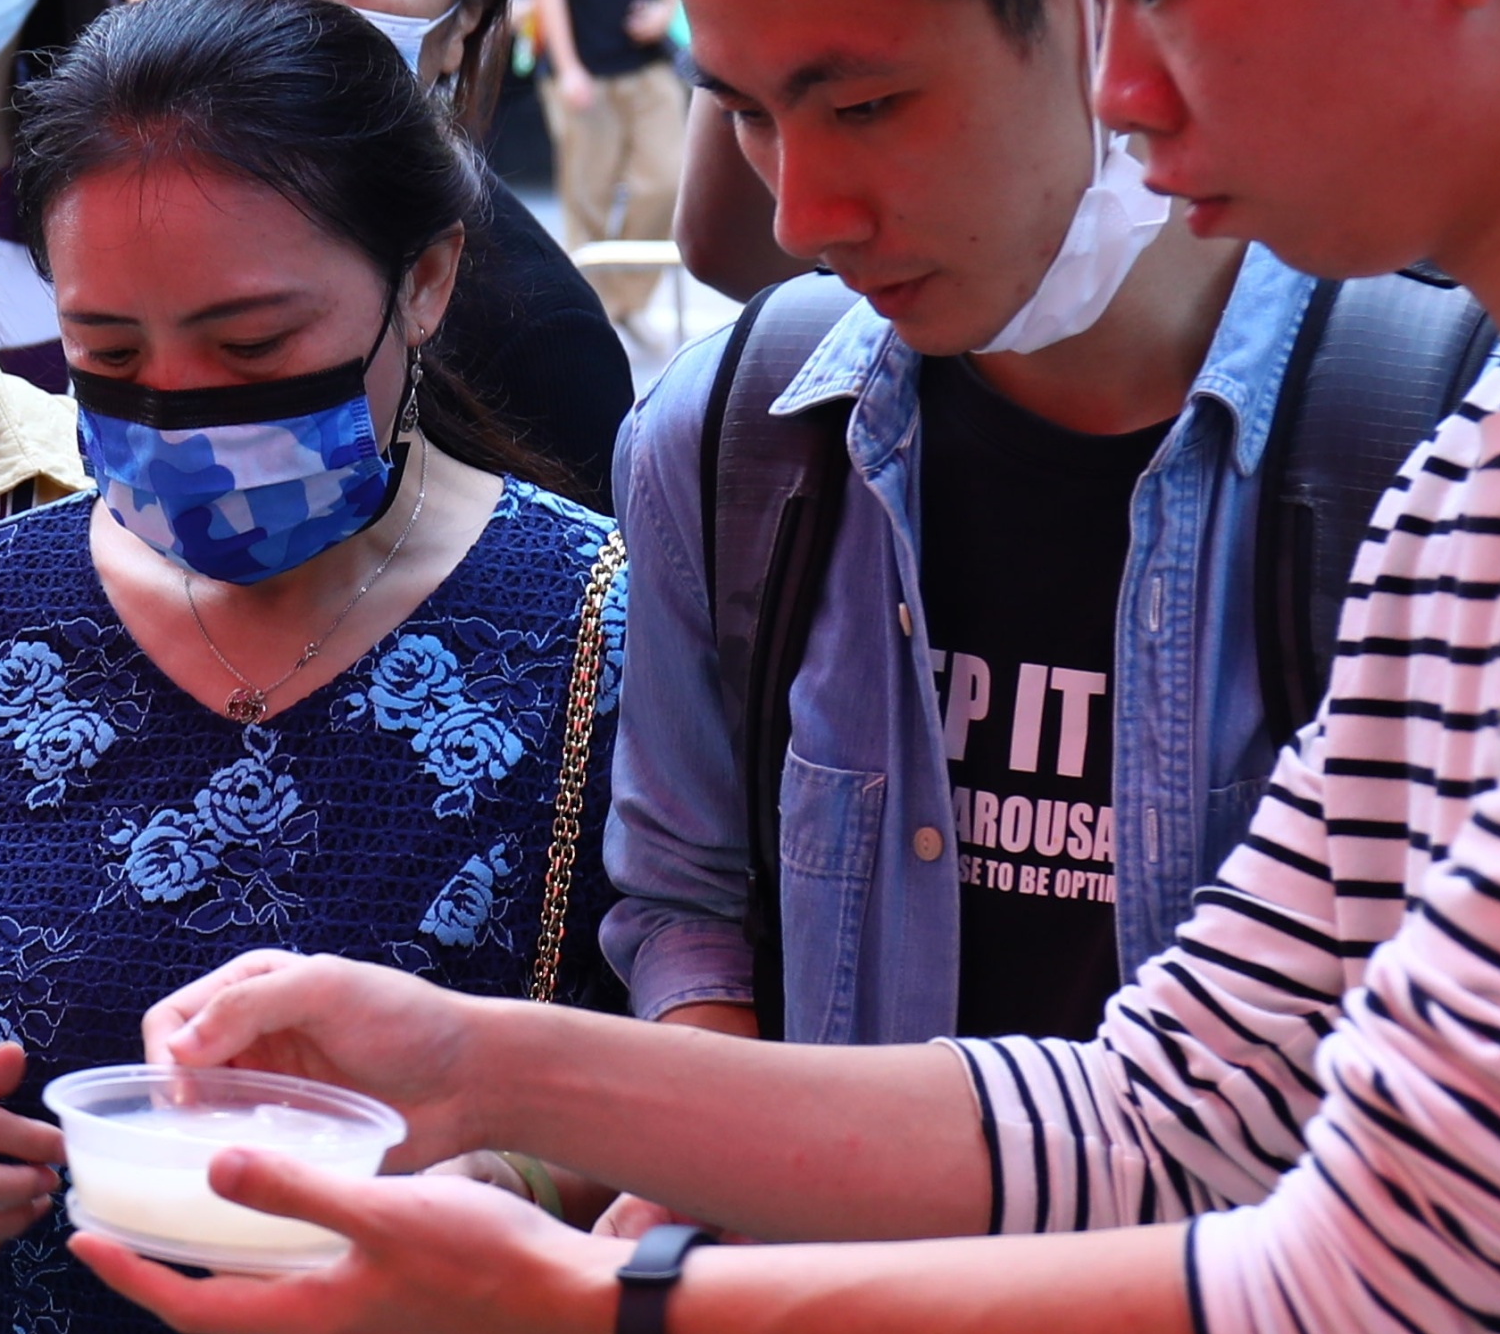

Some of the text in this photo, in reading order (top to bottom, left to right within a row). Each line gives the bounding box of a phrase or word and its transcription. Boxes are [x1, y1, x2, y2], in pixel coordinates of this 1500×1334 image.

[1008, 662, 1107, 778] IT
[985, 859, 1014, 892] TO
[1018, 864, 1051, 897] BE
